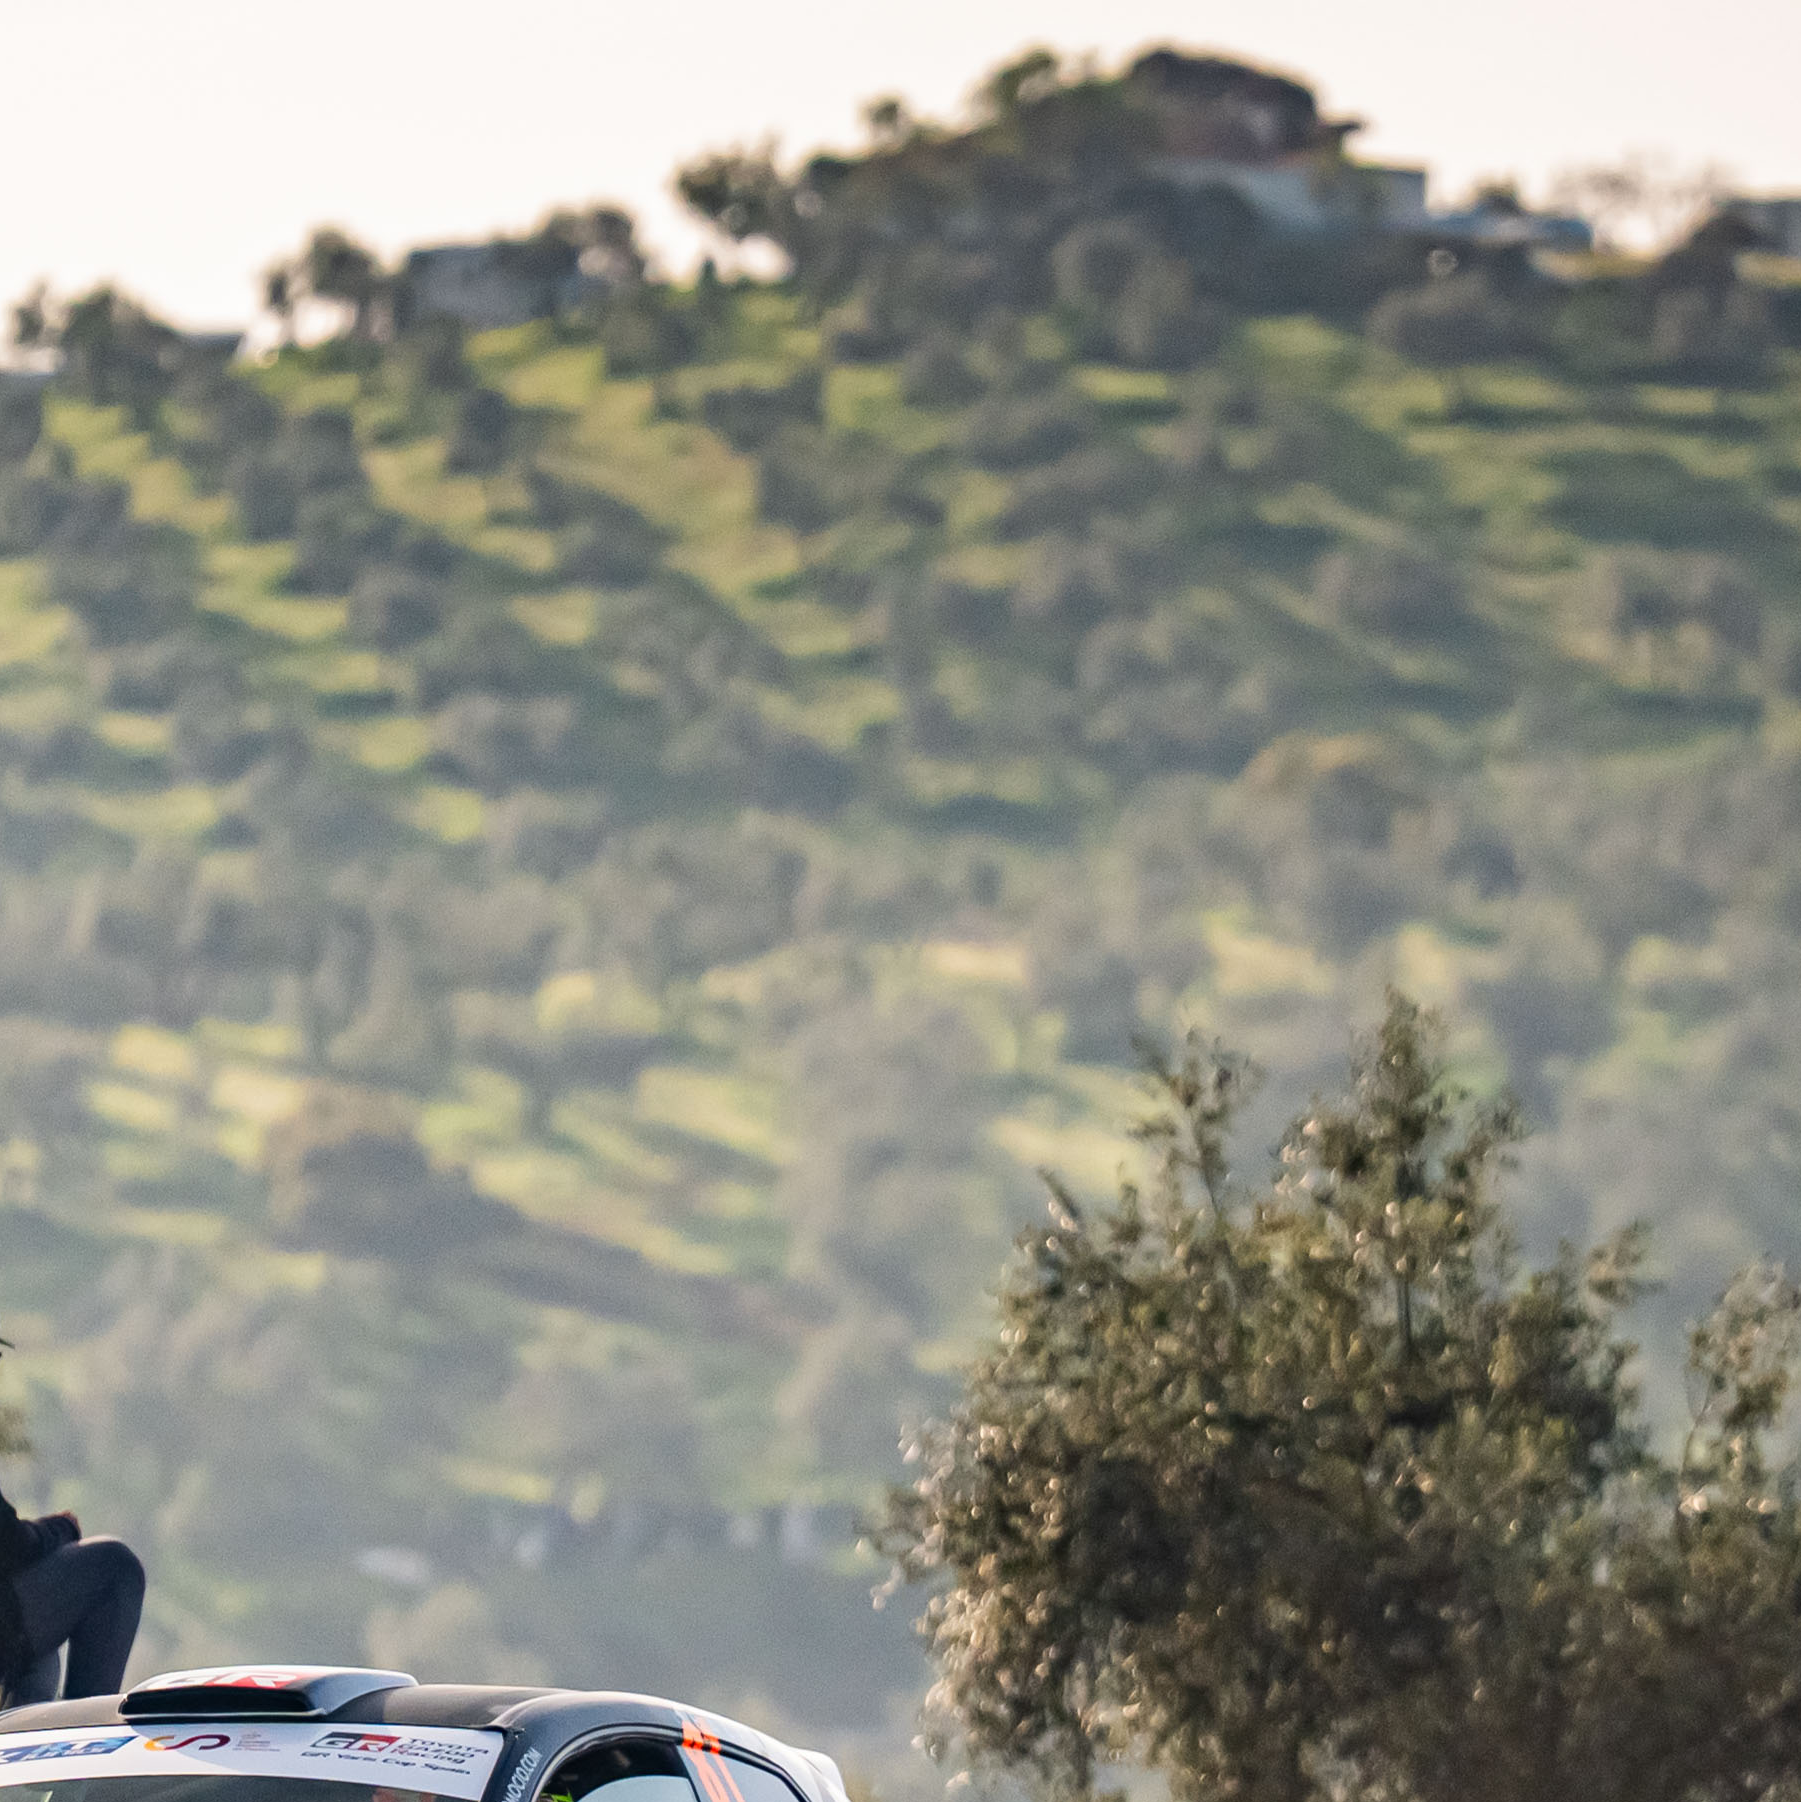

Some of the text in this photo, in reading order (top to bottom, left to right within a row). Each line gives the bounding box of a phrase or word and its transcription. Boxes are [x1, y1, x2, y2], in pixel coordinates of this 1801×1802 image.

[318, 1737, 394, 1753] GR
[409, 1738, 489, 1755] TOYOTA
[382, 1758, 416, 1767] Cup
